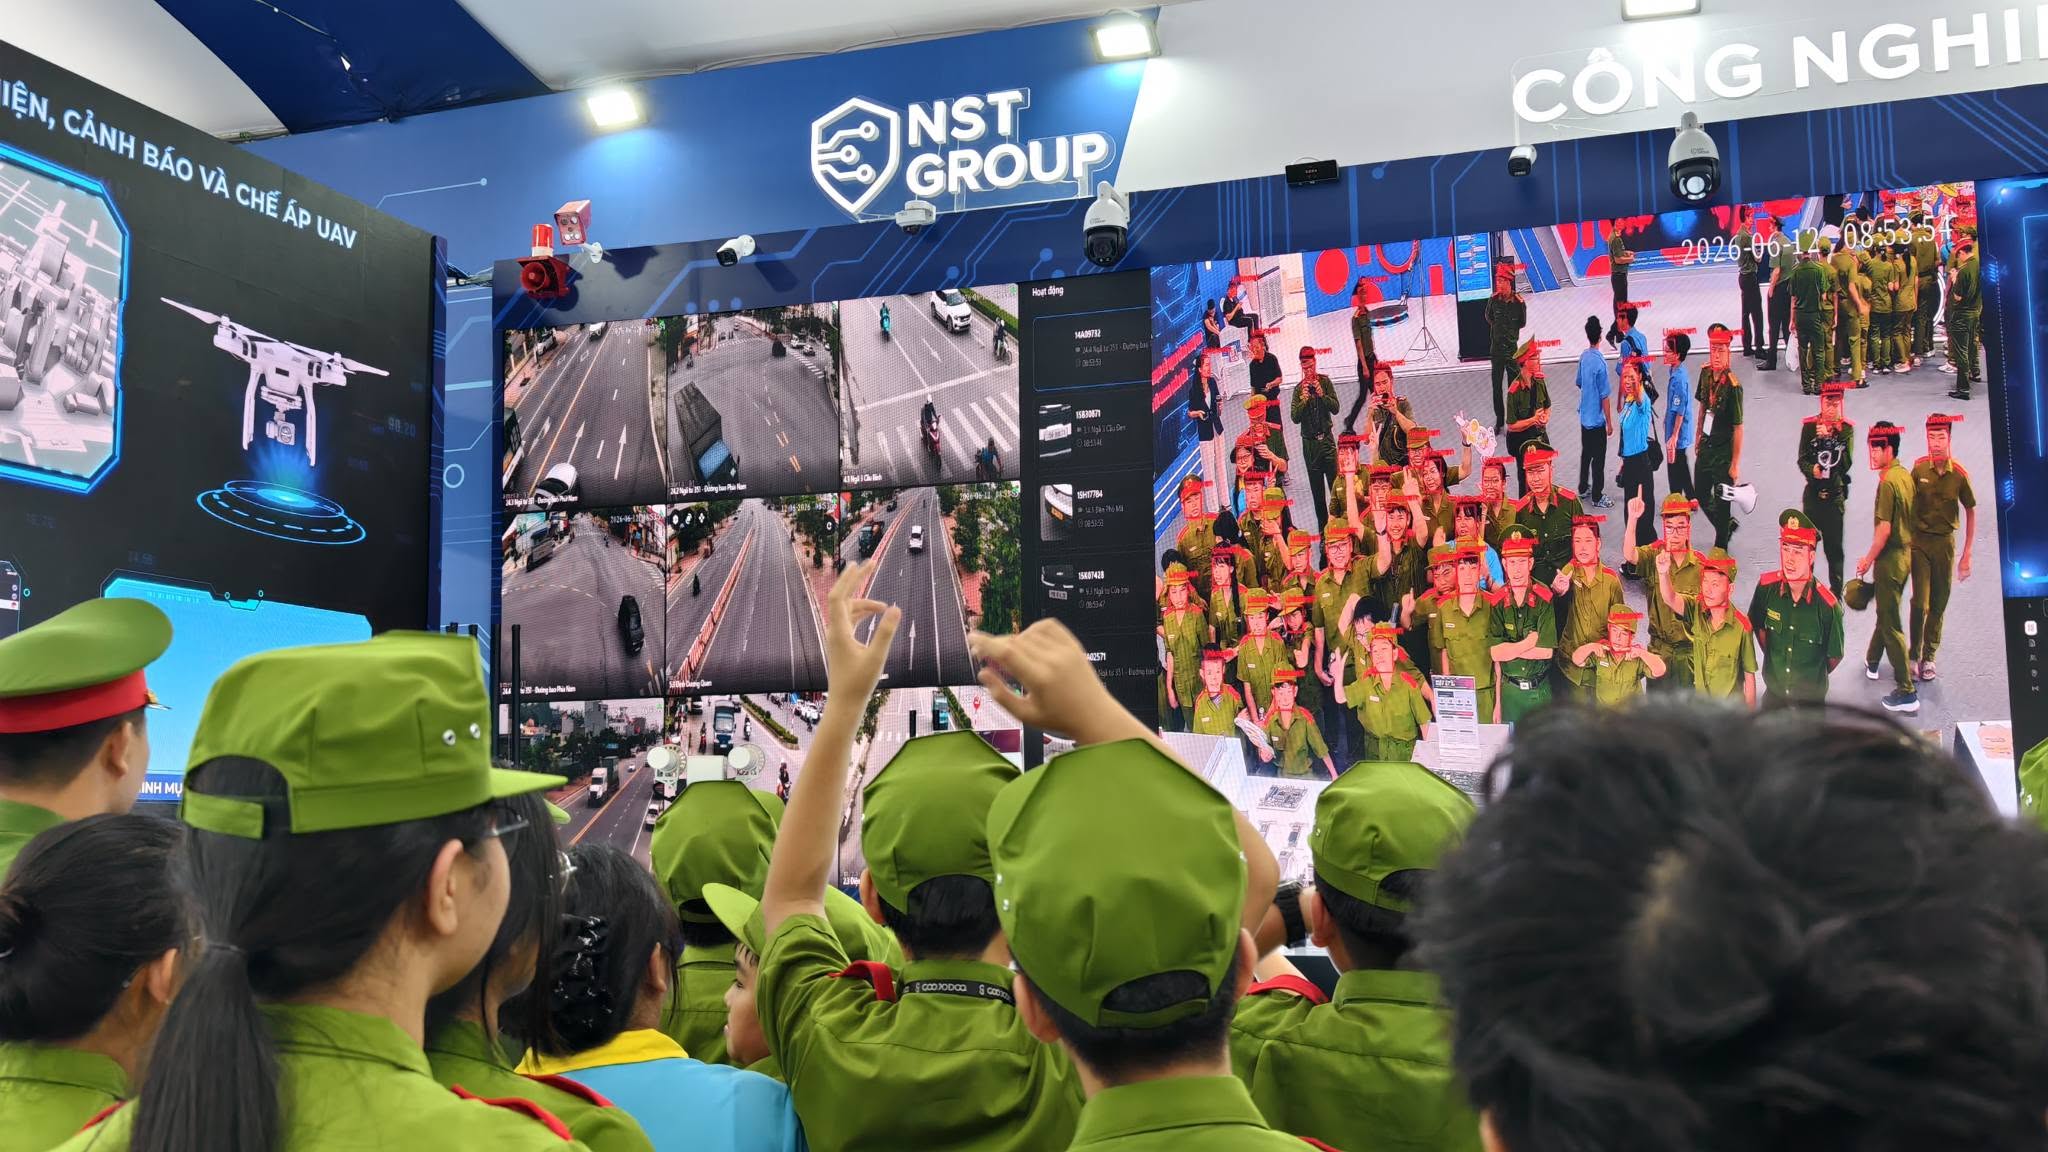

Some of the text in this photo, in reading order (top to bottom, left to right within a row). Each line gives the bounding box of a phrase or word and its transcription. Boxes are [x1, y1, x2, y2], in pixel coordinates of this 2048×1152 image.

[1512, 46, 1762, 122] CÔNG
[908, 90, 1023, 147] NST
[0, 79, 358, 249] IỆN, CẢNH BÁO VÀ CHẾ ÁP UAV
[906, 133, 1109, 198] GROUP
[1681, 212, 1956, 266] 2026-06-12 08:53:54
[1663, 327, 1697, 337] Unknown
[139, 781, 162, 794] INH
